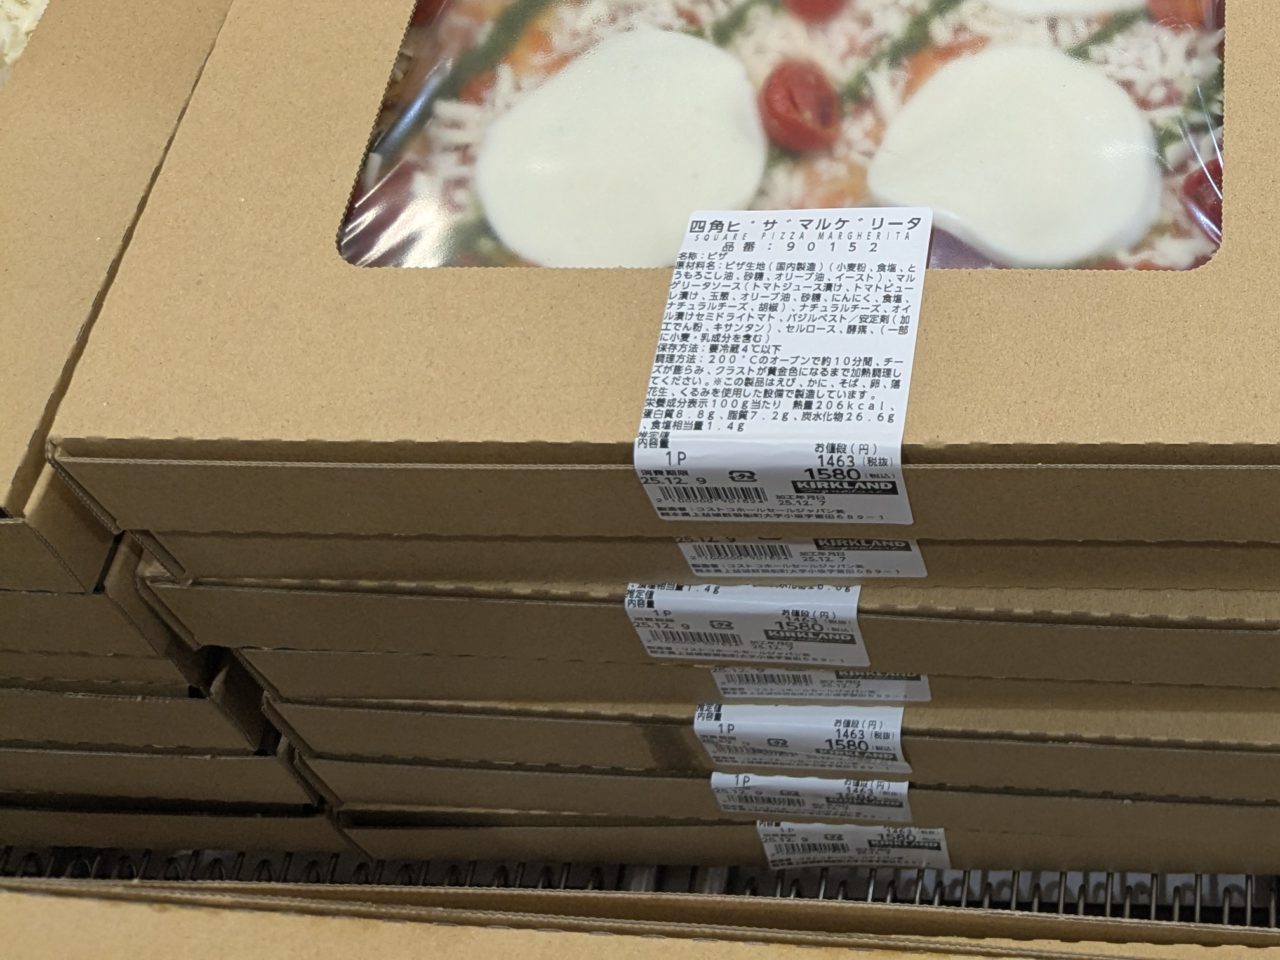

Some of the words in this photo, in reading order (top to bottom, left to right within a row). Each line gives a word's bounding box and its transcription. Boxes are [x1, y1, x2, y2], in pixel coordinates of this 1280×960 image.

[694, 233, 748, 242] SQUARE
[761, 232, 805, 241] PIZZA
[817, 231, 911, 241] MARGHERITA
[679, 251, 728, 261] 名称：ピザ
[637, 438, 669, 449] 内容量
[666, 451, 687, 466] 1P
[818, 455, 855, 467] 1463
[804, 468, 861, 481] 1580
[796, 481, 894, 490] KIRKLAND
[774, 621, 824, 632] 1580
[768, 630, 851, 640] KIRKLAND
[718, 723, 735, 734] 1P
[836, 728, 865, 740] 1463
[825, 738, 869, 752] 1580
